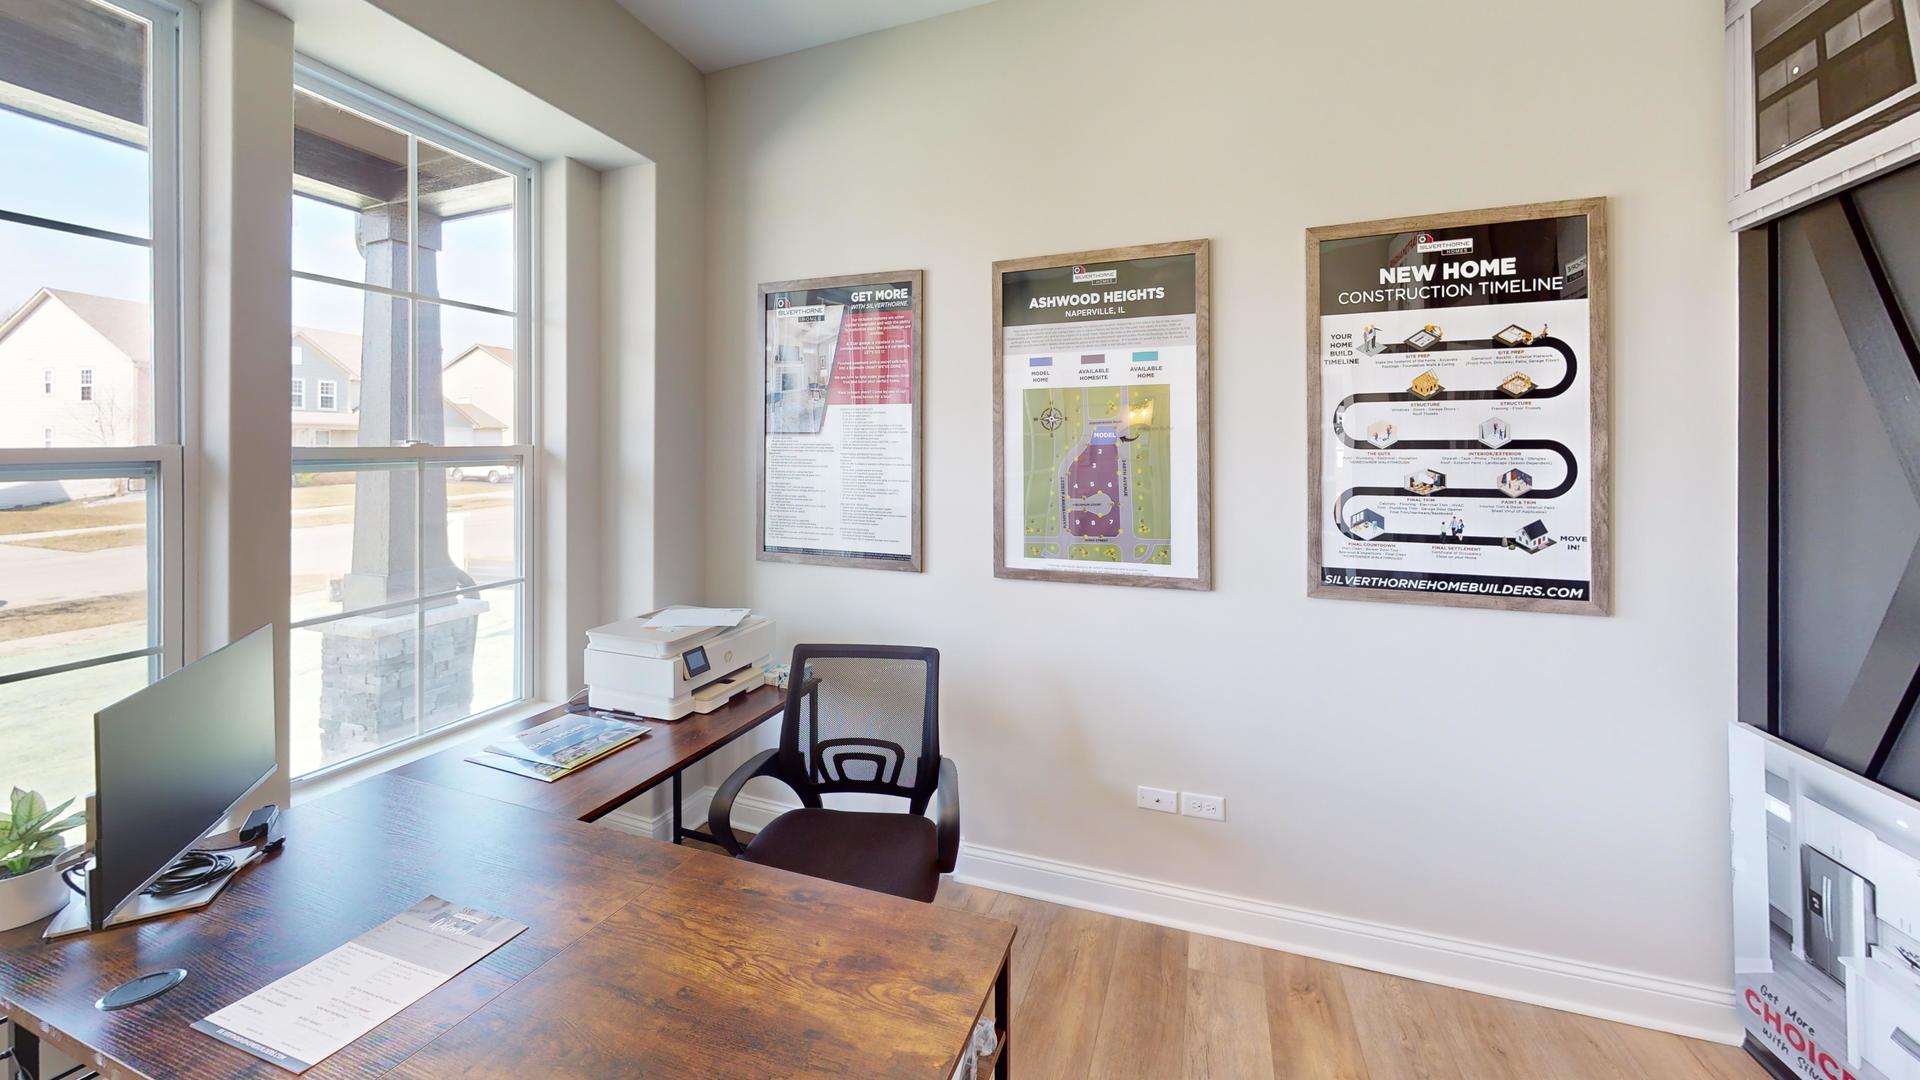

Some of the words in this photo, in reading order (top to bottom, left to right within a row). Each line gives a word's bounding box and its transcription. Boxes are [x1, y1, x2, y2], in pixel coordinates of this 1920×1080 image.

[1419, 240, 1471, 250] SILVERTHORNE
[1379, 264, 1436, 284] NEW
[1443, 257, 1516, 280] HOME
[851, 290, 873, 302] GET
[875, 288, 908, 300] MORE
[1028, 294, 1100, 309] ASHWOOD
[1104, 287, 1165, 304] HEIGHTS
[1338, 283, 1473, 304] CONSTRUCTION
[1478, 276, 1564, 294] TIMELINE
[1065, 308, 1116, 318] NAPERVILLE,
[1325, 574, 1584, 598] SILVERTHORNEHOMEBUILDERS.COM
[1760, 984, 1780, 1004] Get
[1784, 1005, 1816, 1036] More
[1762, 1028, 1790, 1054] with
